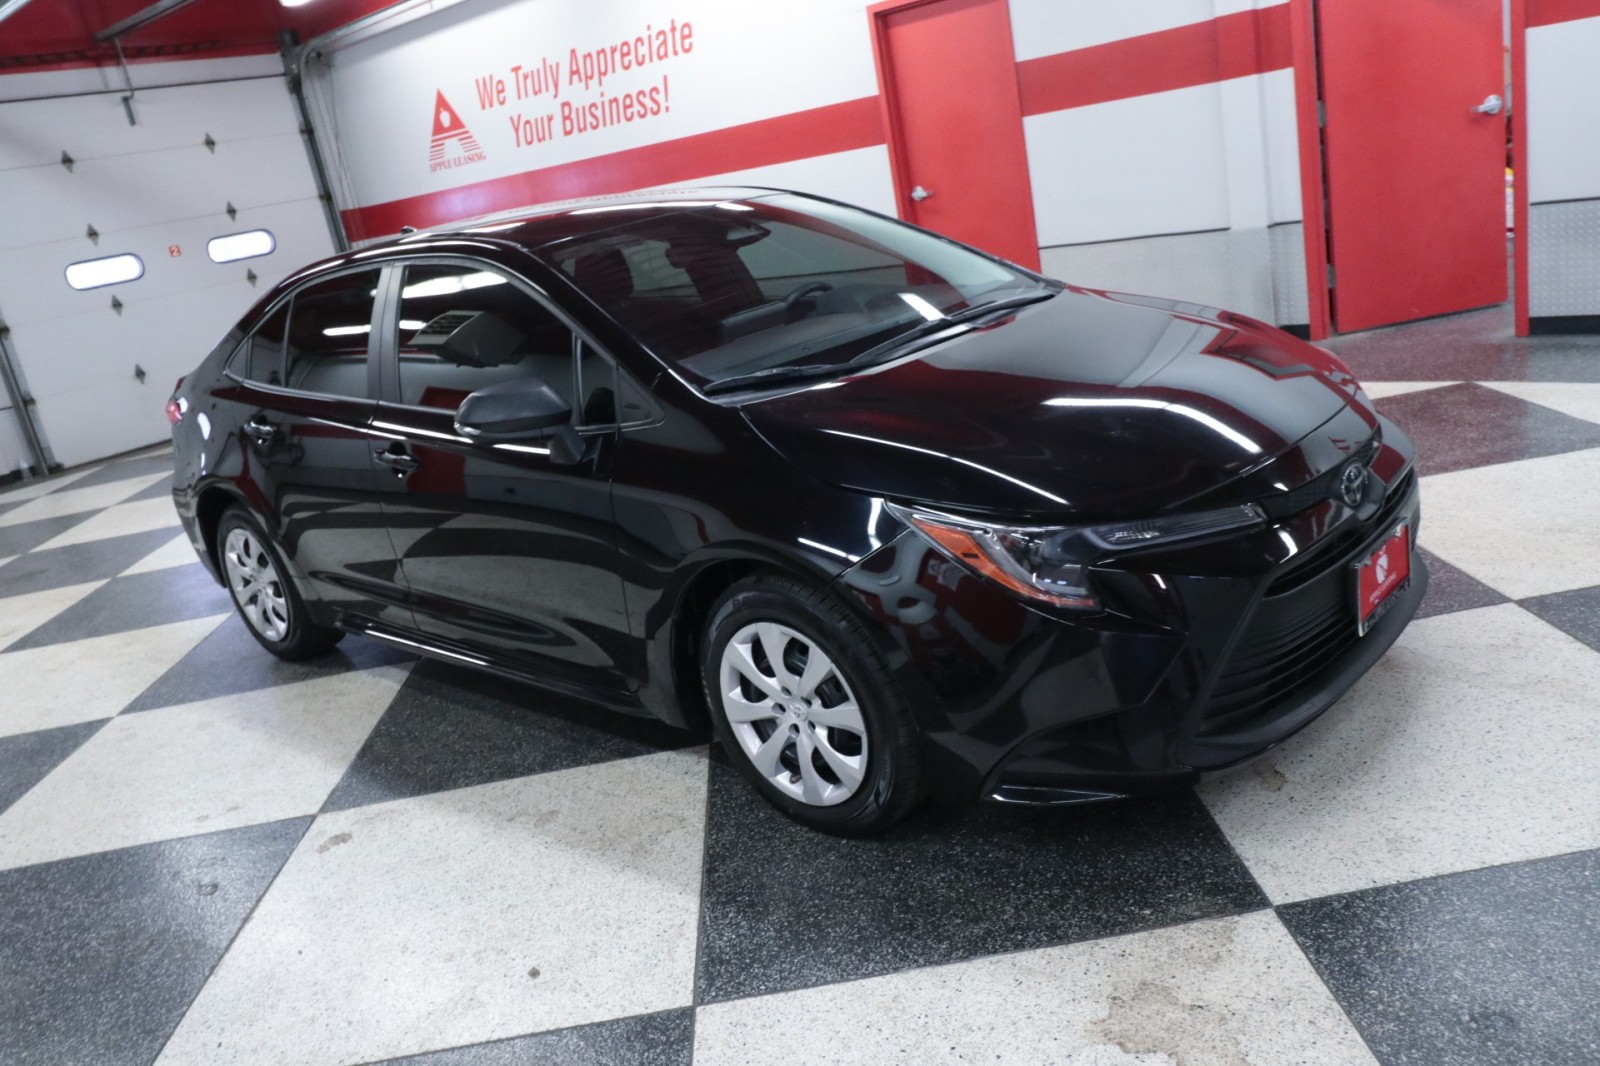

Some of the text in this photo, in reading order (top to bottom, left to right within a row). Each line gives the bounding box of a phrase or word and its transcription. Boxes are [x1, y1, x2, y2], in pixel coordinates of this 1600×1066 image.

[475, 18, 694, 111] We Truly Appreciate
[509, 74, 671, 148] Your Business!
[169, 245, 181, 257] 2
